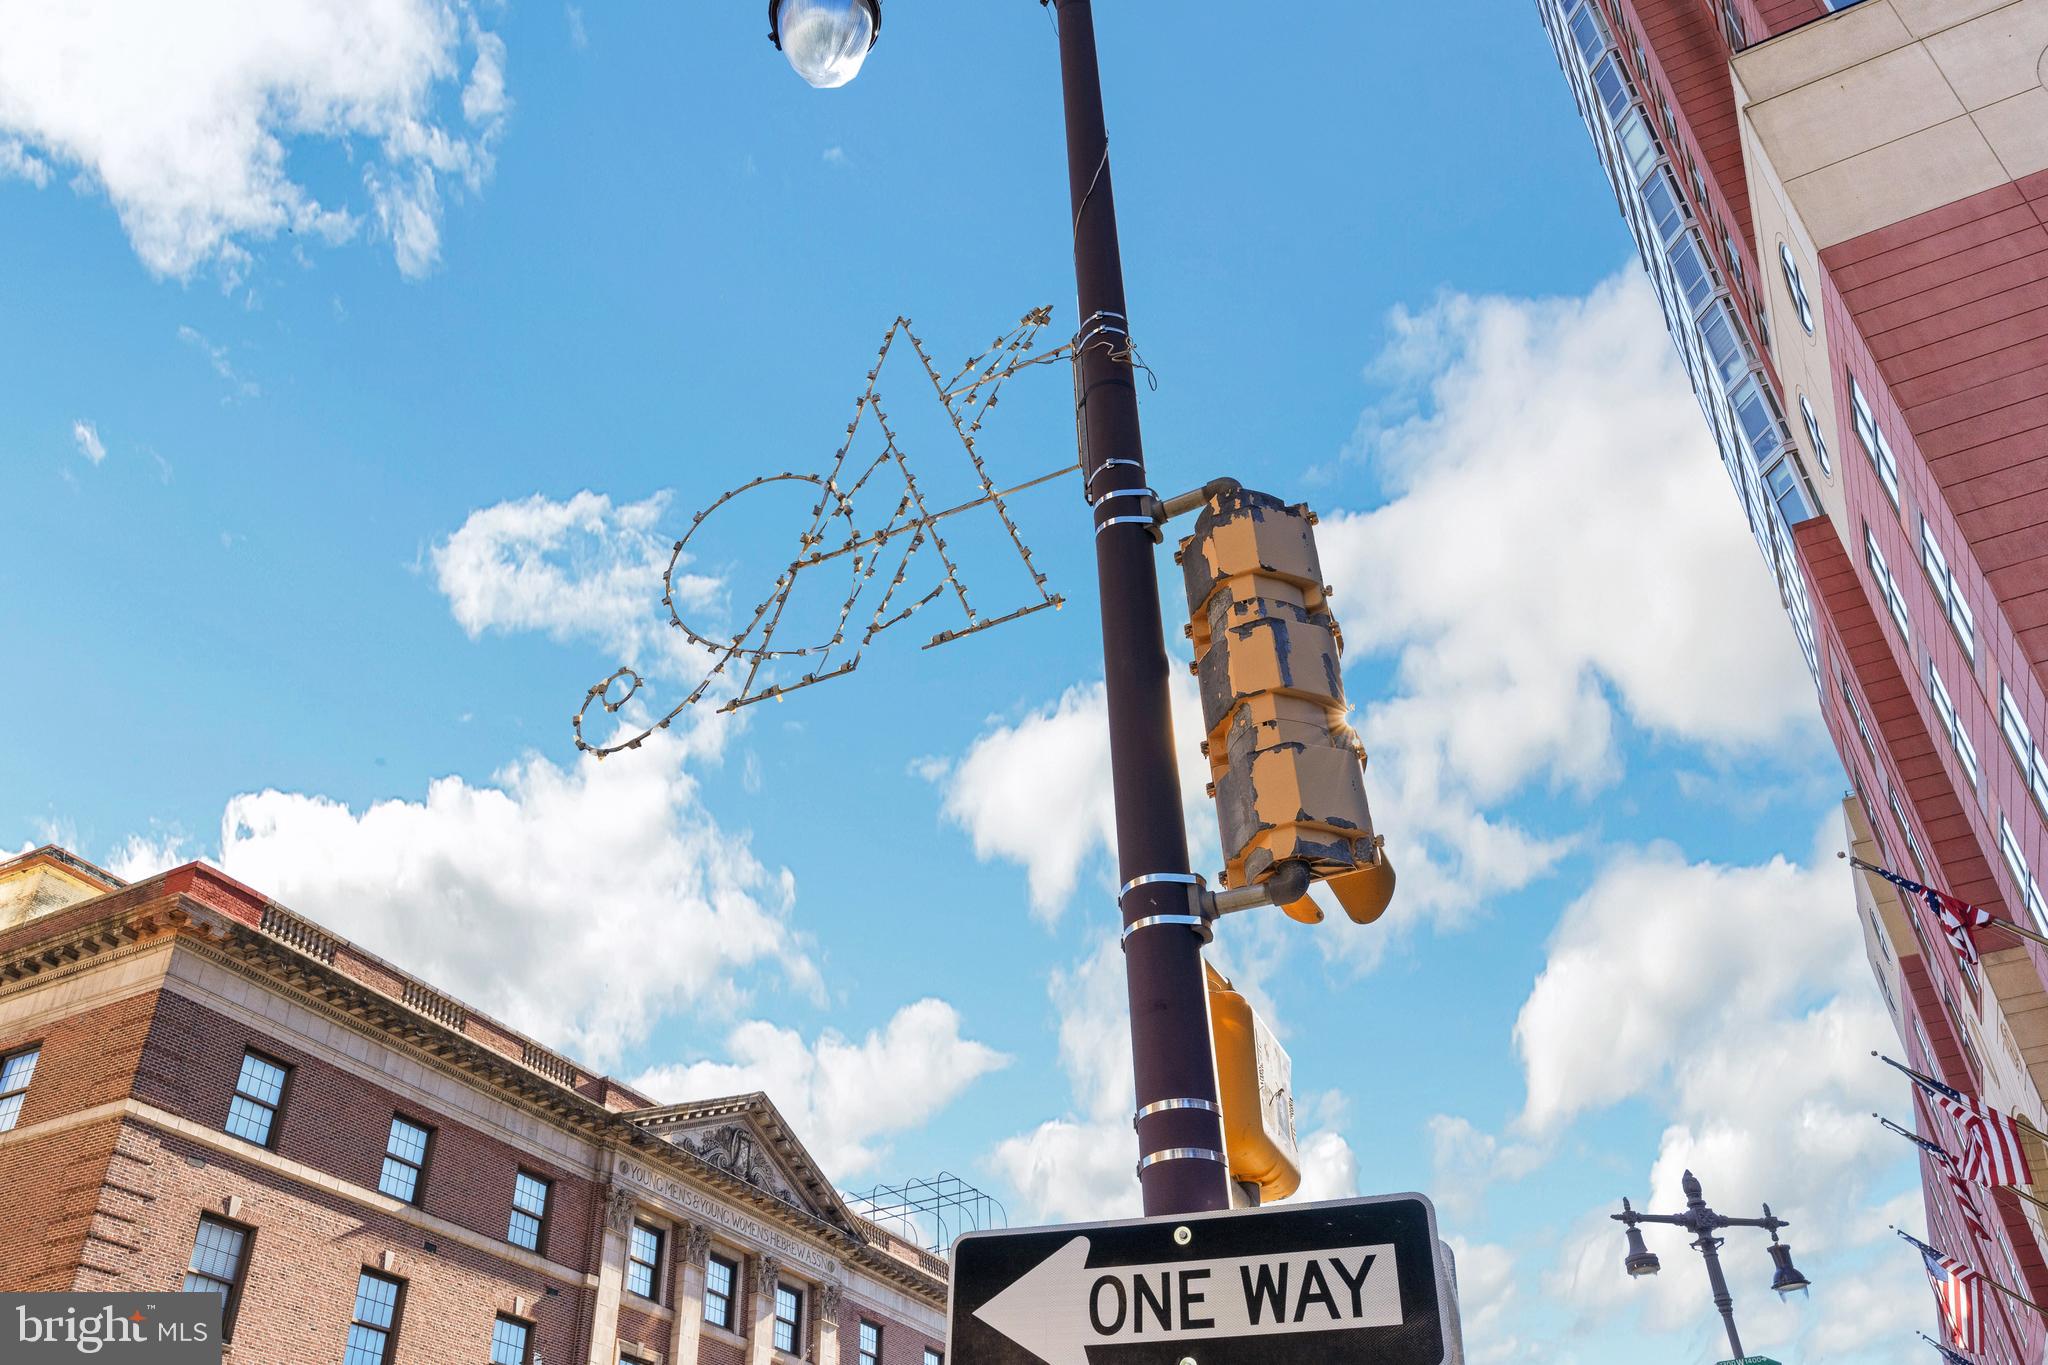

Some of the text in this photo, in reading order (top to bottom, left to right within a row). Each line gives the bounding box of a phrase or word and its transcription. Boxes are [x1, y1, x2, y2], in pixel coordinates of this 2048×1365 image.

[630, 1164, 663, 1192] YOUNG
[692, 1195, 700, 1209] &
[700, 1197, 730, 1223] YOUNG
[769, 1231, 806, 1259] HEBREW
[1089, 1254, 1377, 1336] ONE WAY
